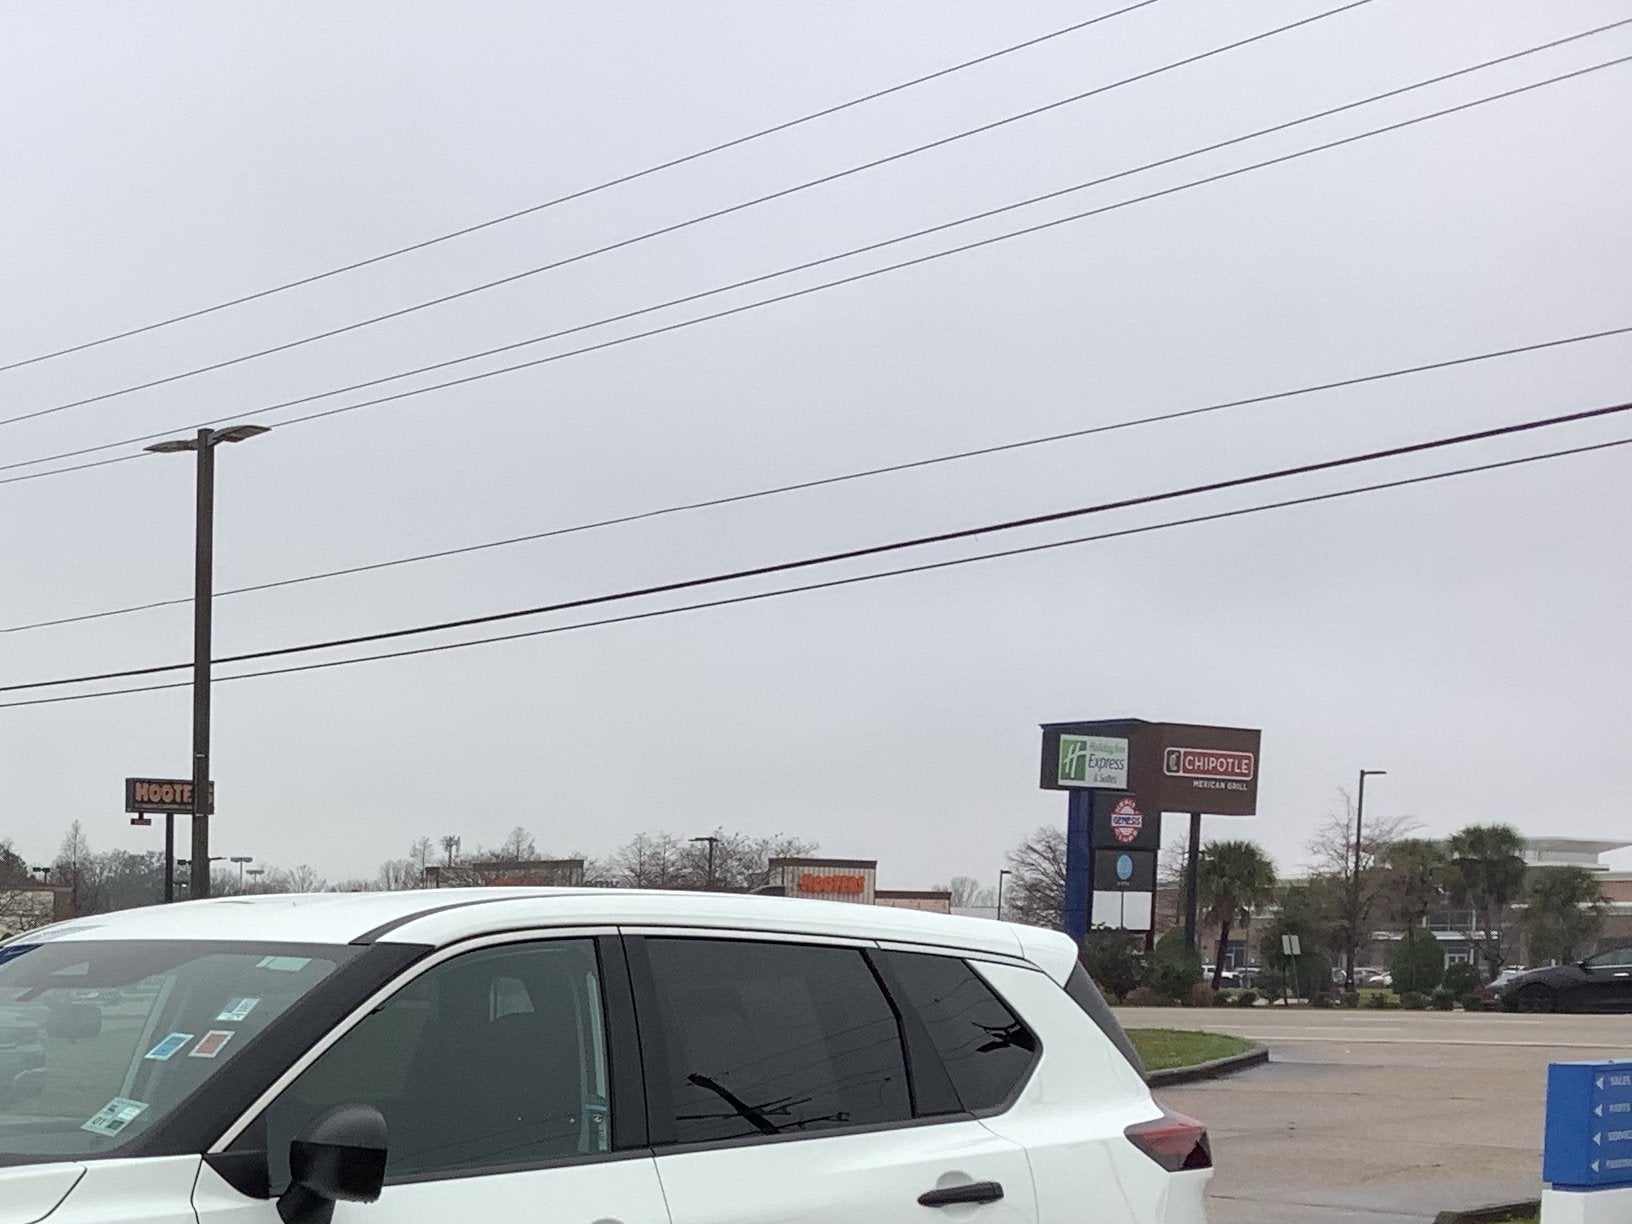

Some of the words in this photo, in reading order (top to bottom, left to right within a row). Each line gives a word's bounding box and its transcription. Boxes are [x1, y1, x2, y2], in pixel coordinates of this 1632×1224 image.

[1088, 754, 1125, 770] Express
[1185, 755, 1249, 774] CHIPOTLE
[135, 782, 212, 804] HOOTE
[1193, 780, 1225, 789] MEXICAN
[1227, 782, 1247, 791] GRILL
[1113, 815, 1141, 826] GENESIS
